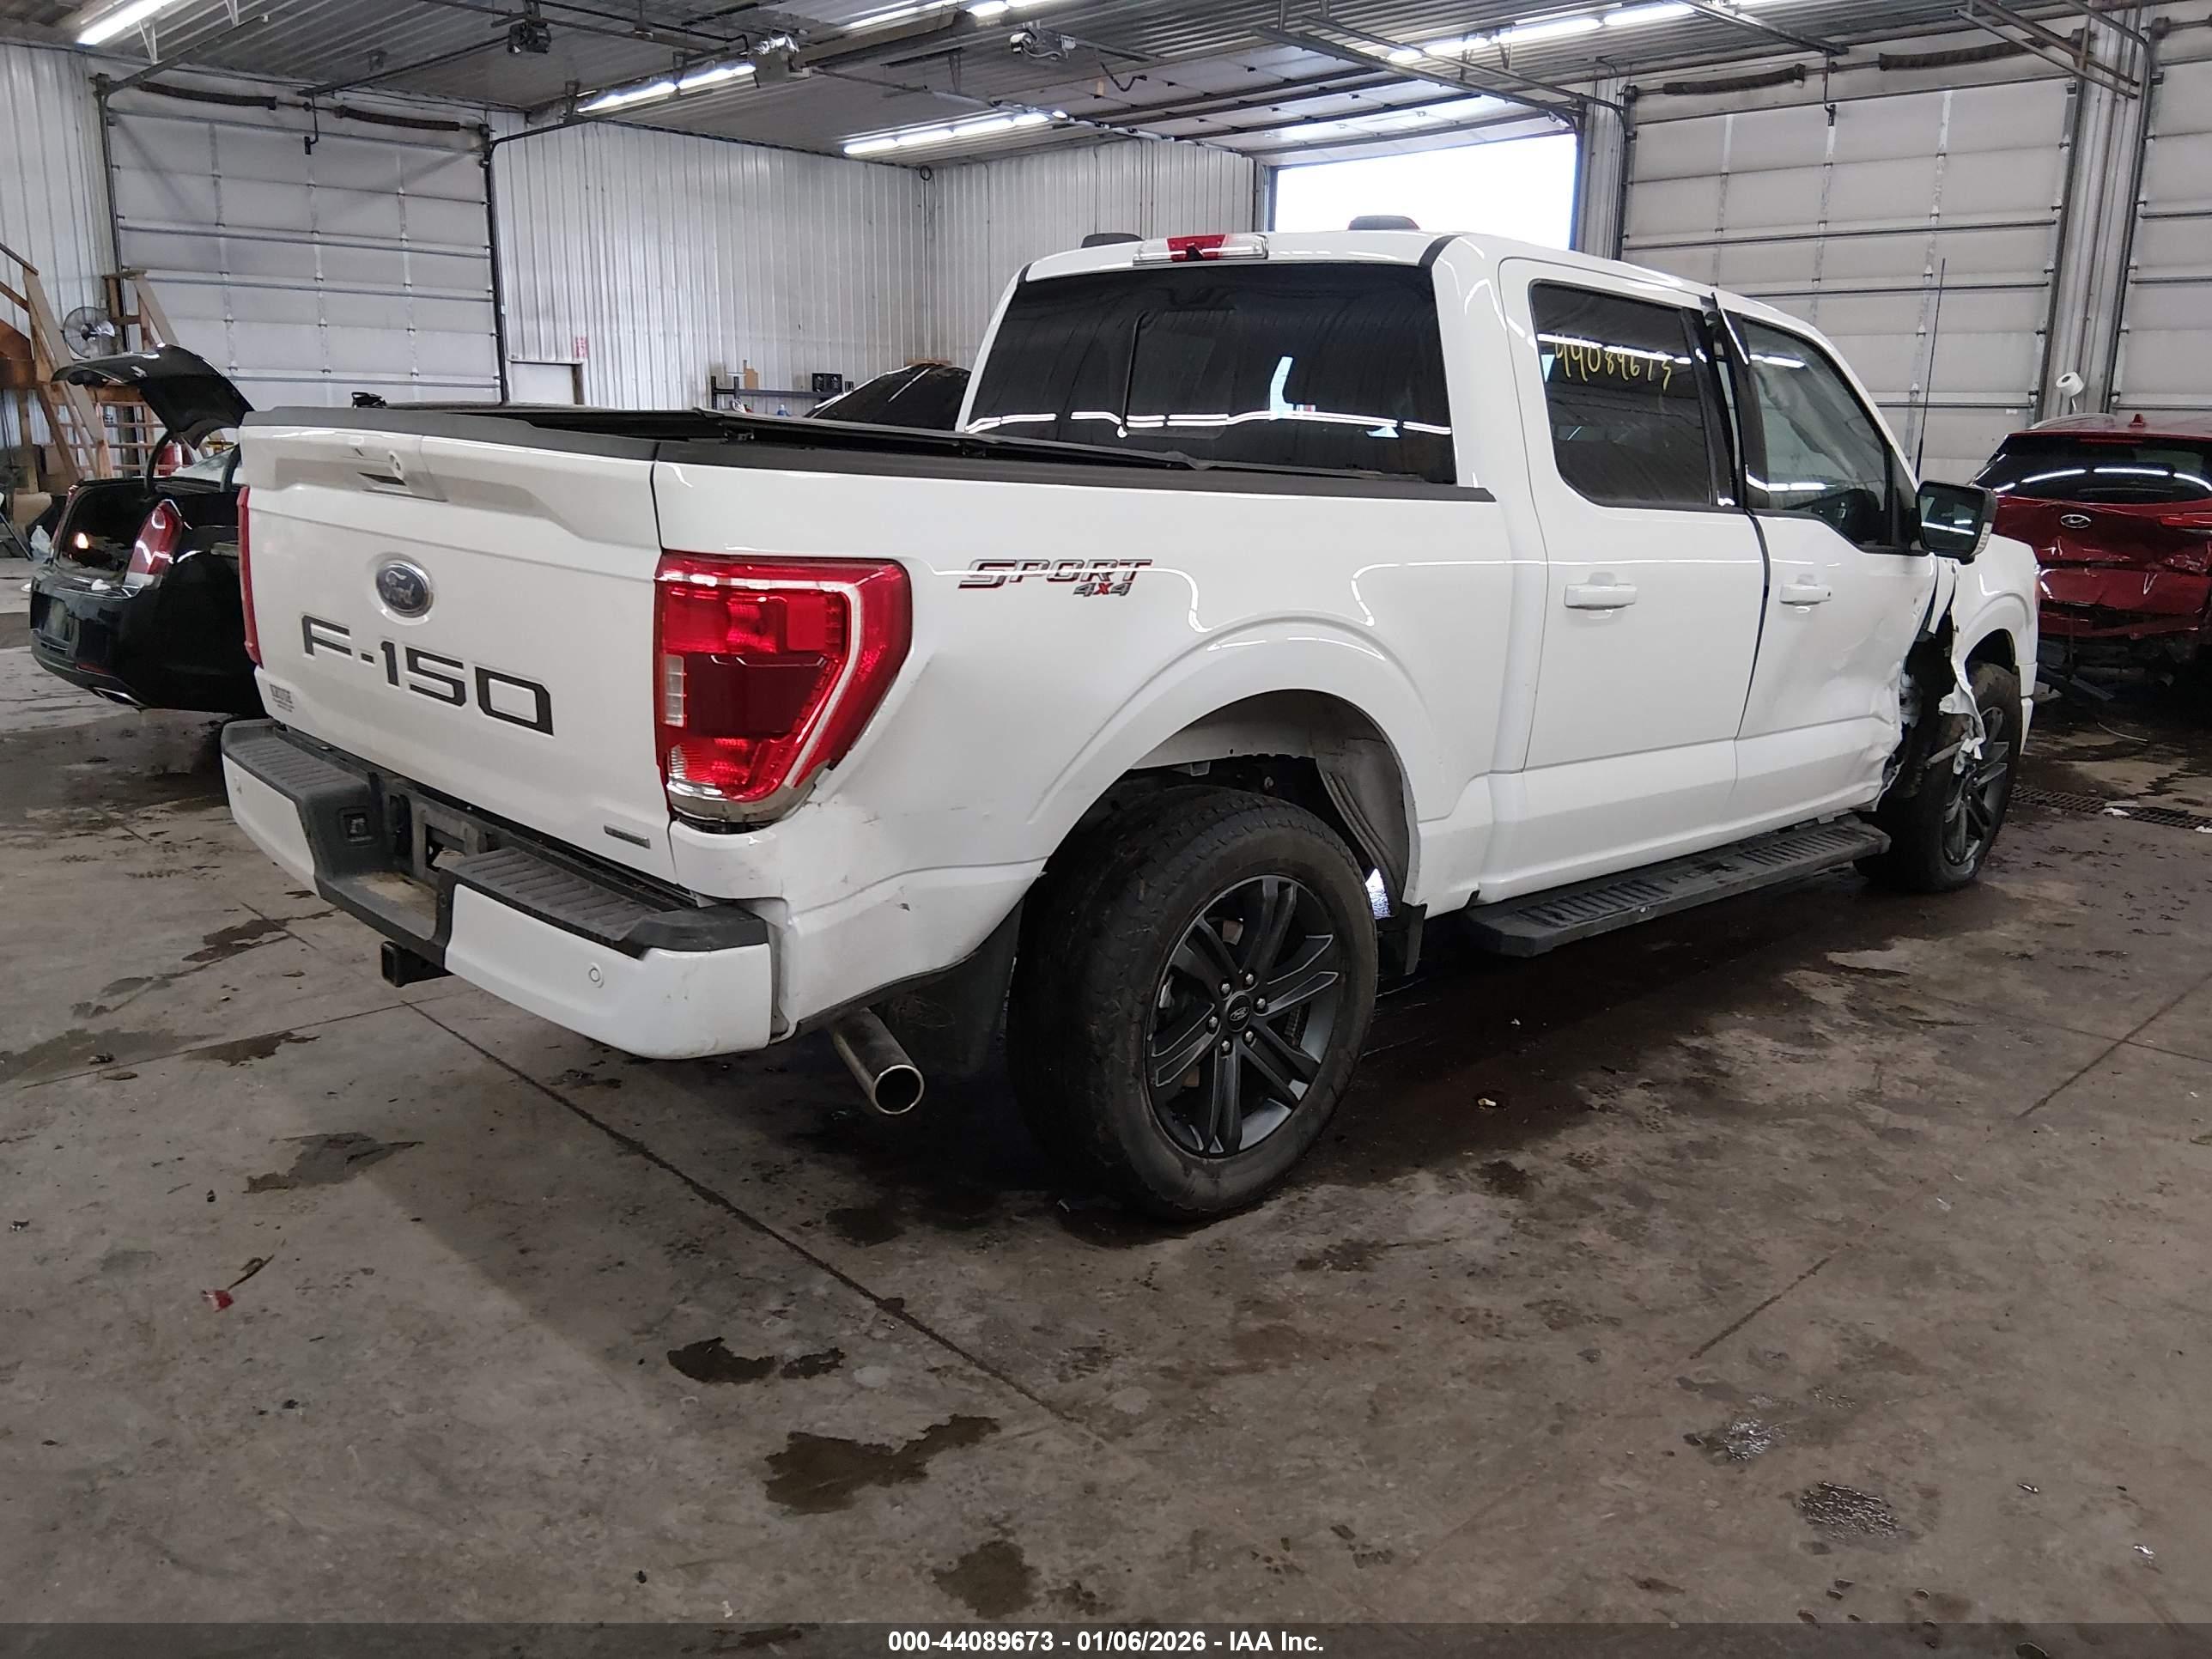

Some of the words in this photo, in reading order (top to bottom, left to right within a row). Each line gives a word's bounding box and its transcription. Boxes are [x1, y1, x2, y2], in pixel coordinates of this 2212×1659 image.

[384, 569, 415, 605] Ford
[957, 558, 1152, 589] SPORT
[301, 614, 554, 737] F-150
